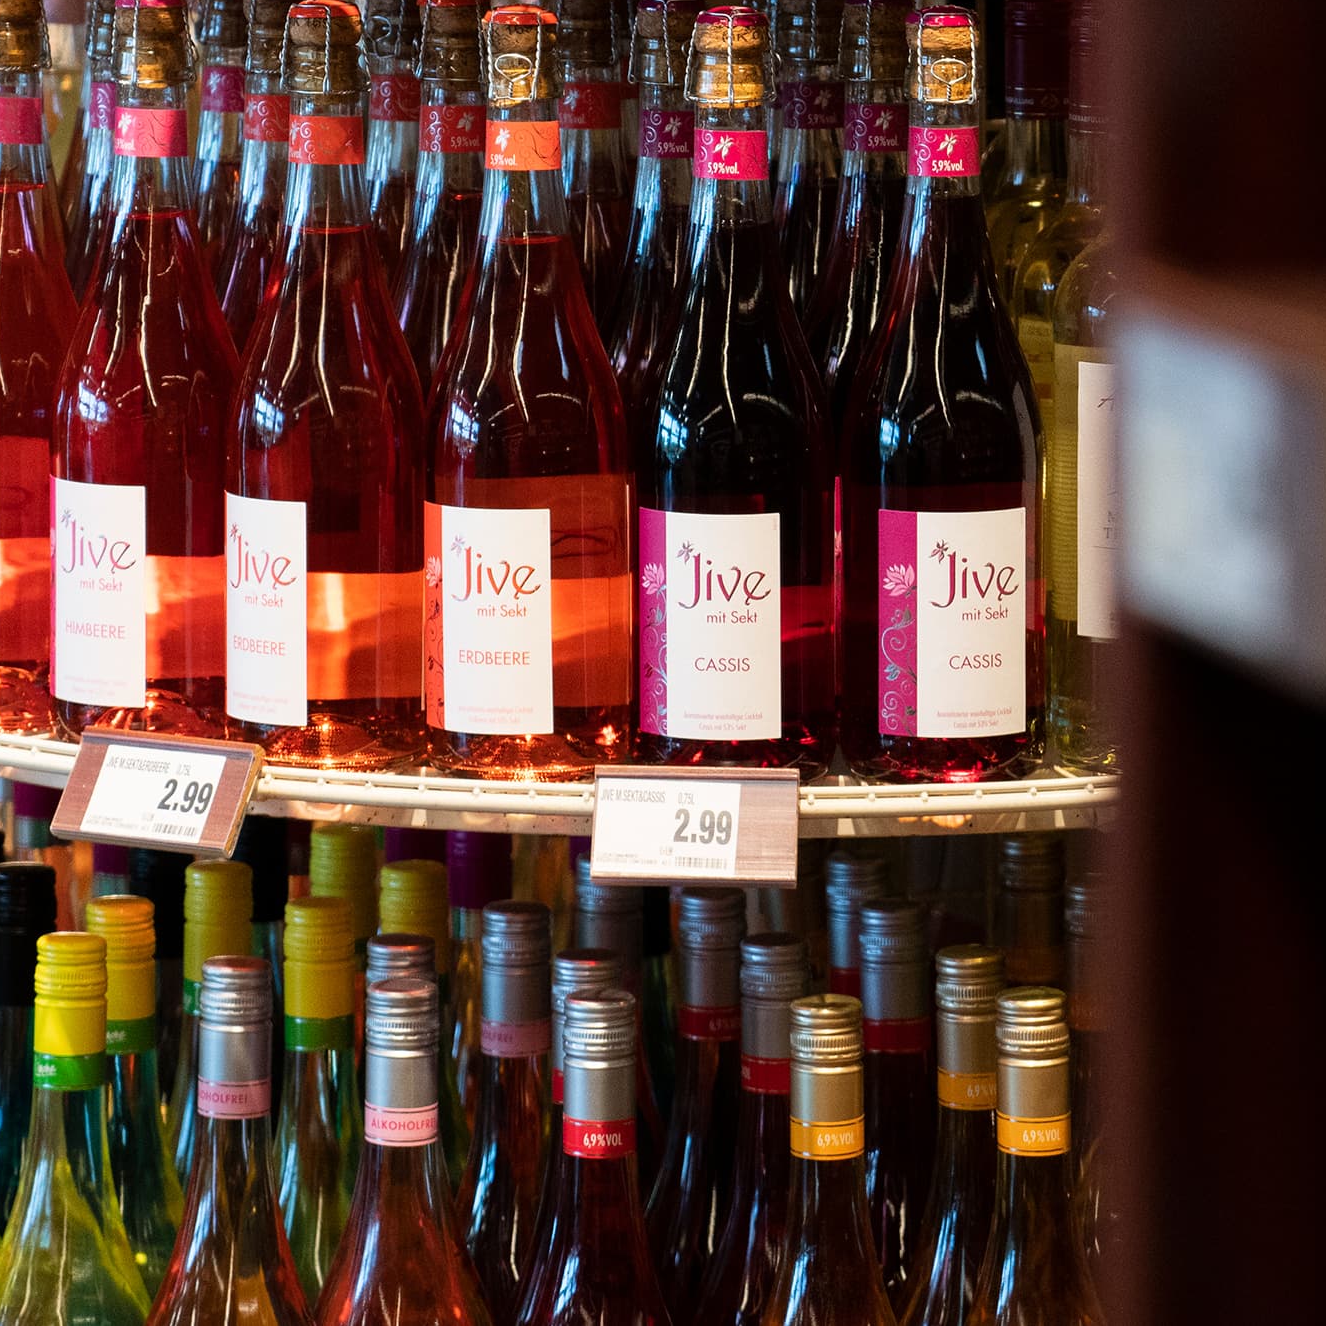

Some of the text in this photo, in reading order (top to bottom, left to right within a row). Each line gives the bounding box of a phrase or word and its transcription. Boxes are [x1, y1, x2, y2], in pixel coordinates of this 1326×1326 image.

[61, 519, 136, 574] Jive
[230, 535, 297, 590] Jive
[451, 546, 541, 602] Jive
[678, 552, 772, 609] Jive
[931, 551, 1019, 608] Jive
[79, 578, 123, 593] mit Sekt
[244, 593, 284, 608] mit Sekt
[477, 604, 527, 617] mit Sekt
[707, 610, 758, 624] mit Sekt
[962, 604, 1009, 621] mit Sekt
[65, 620, 126, 640] HIMBEERE
[233, 635, 286, 656] ERDBEERE
[459, 650, 530, 665] ERDBEERE
[694, 657, 751, 672] CASSIS
[949, 653, 1003, 669] CASSIS
[157, 778, 213, 815] 2.99
[673, 808, 732, 845] 2.99
[583, 1132, 624, 1148] 6,9%VOL
[817, 1132, 855, 1147] 6,9%VOL
[1023, 1130, 1061, 1144] 6,9%VOL
